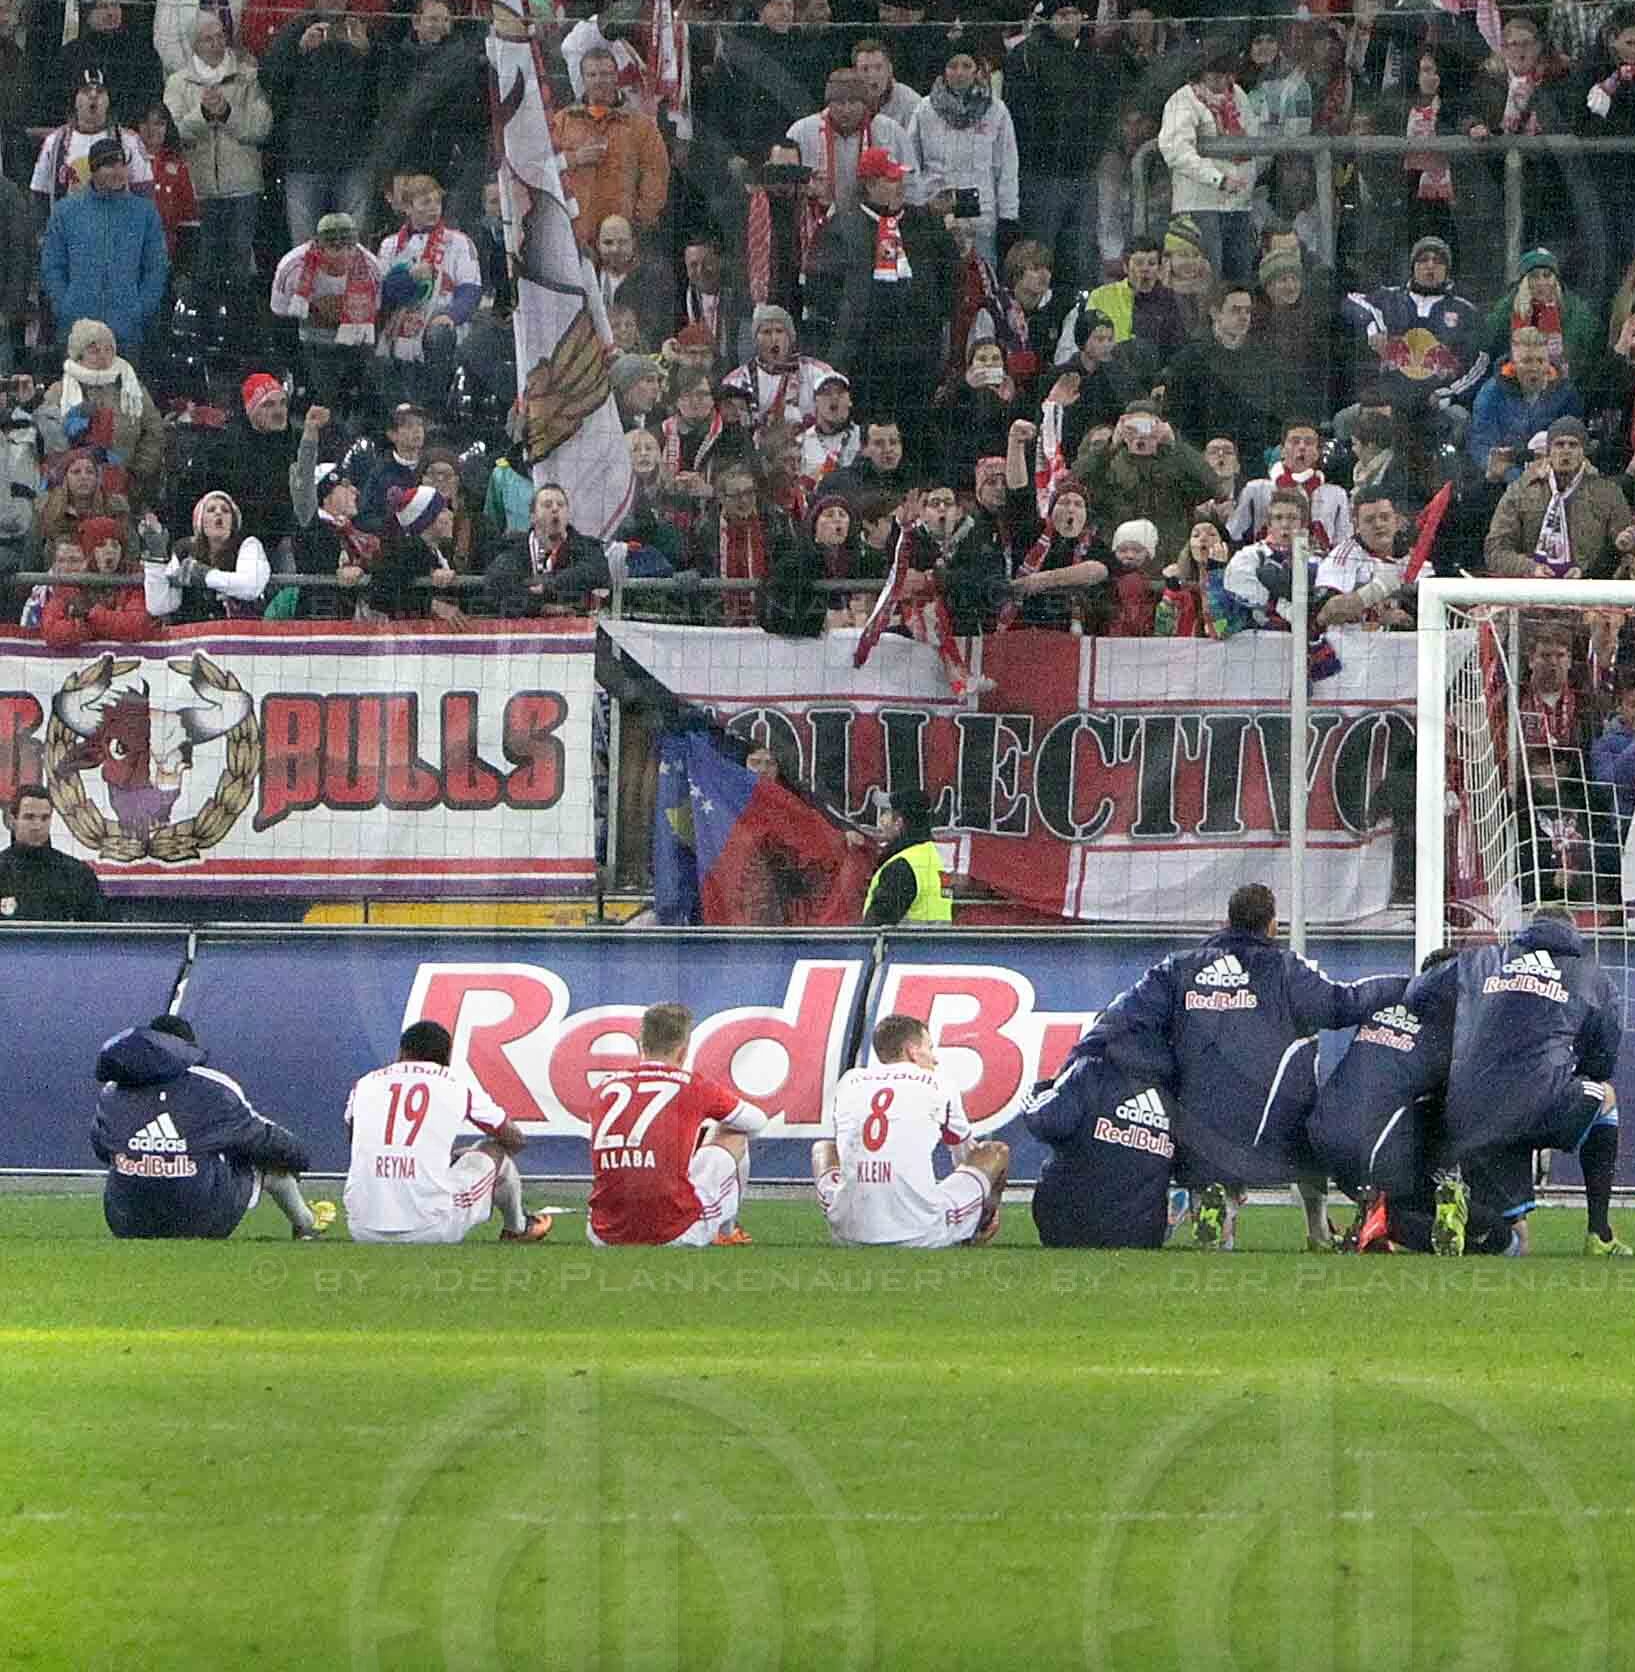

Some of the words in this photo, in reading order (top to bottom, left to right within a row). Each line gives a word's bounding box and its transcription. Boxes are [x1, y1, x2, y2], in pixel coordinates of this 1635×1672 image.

[253, 690, 569, 833] BULLS
[383, 1082, 431, 1147] 19
[594, 1080, 683, 1149] 27
[861, 1086, 896, 1153] 8
[375, 1155, 416, 1180] REYNA
[600, 1148, 656, 1170] ALABA
[857, 1159, 892, 1185] KLEIN
